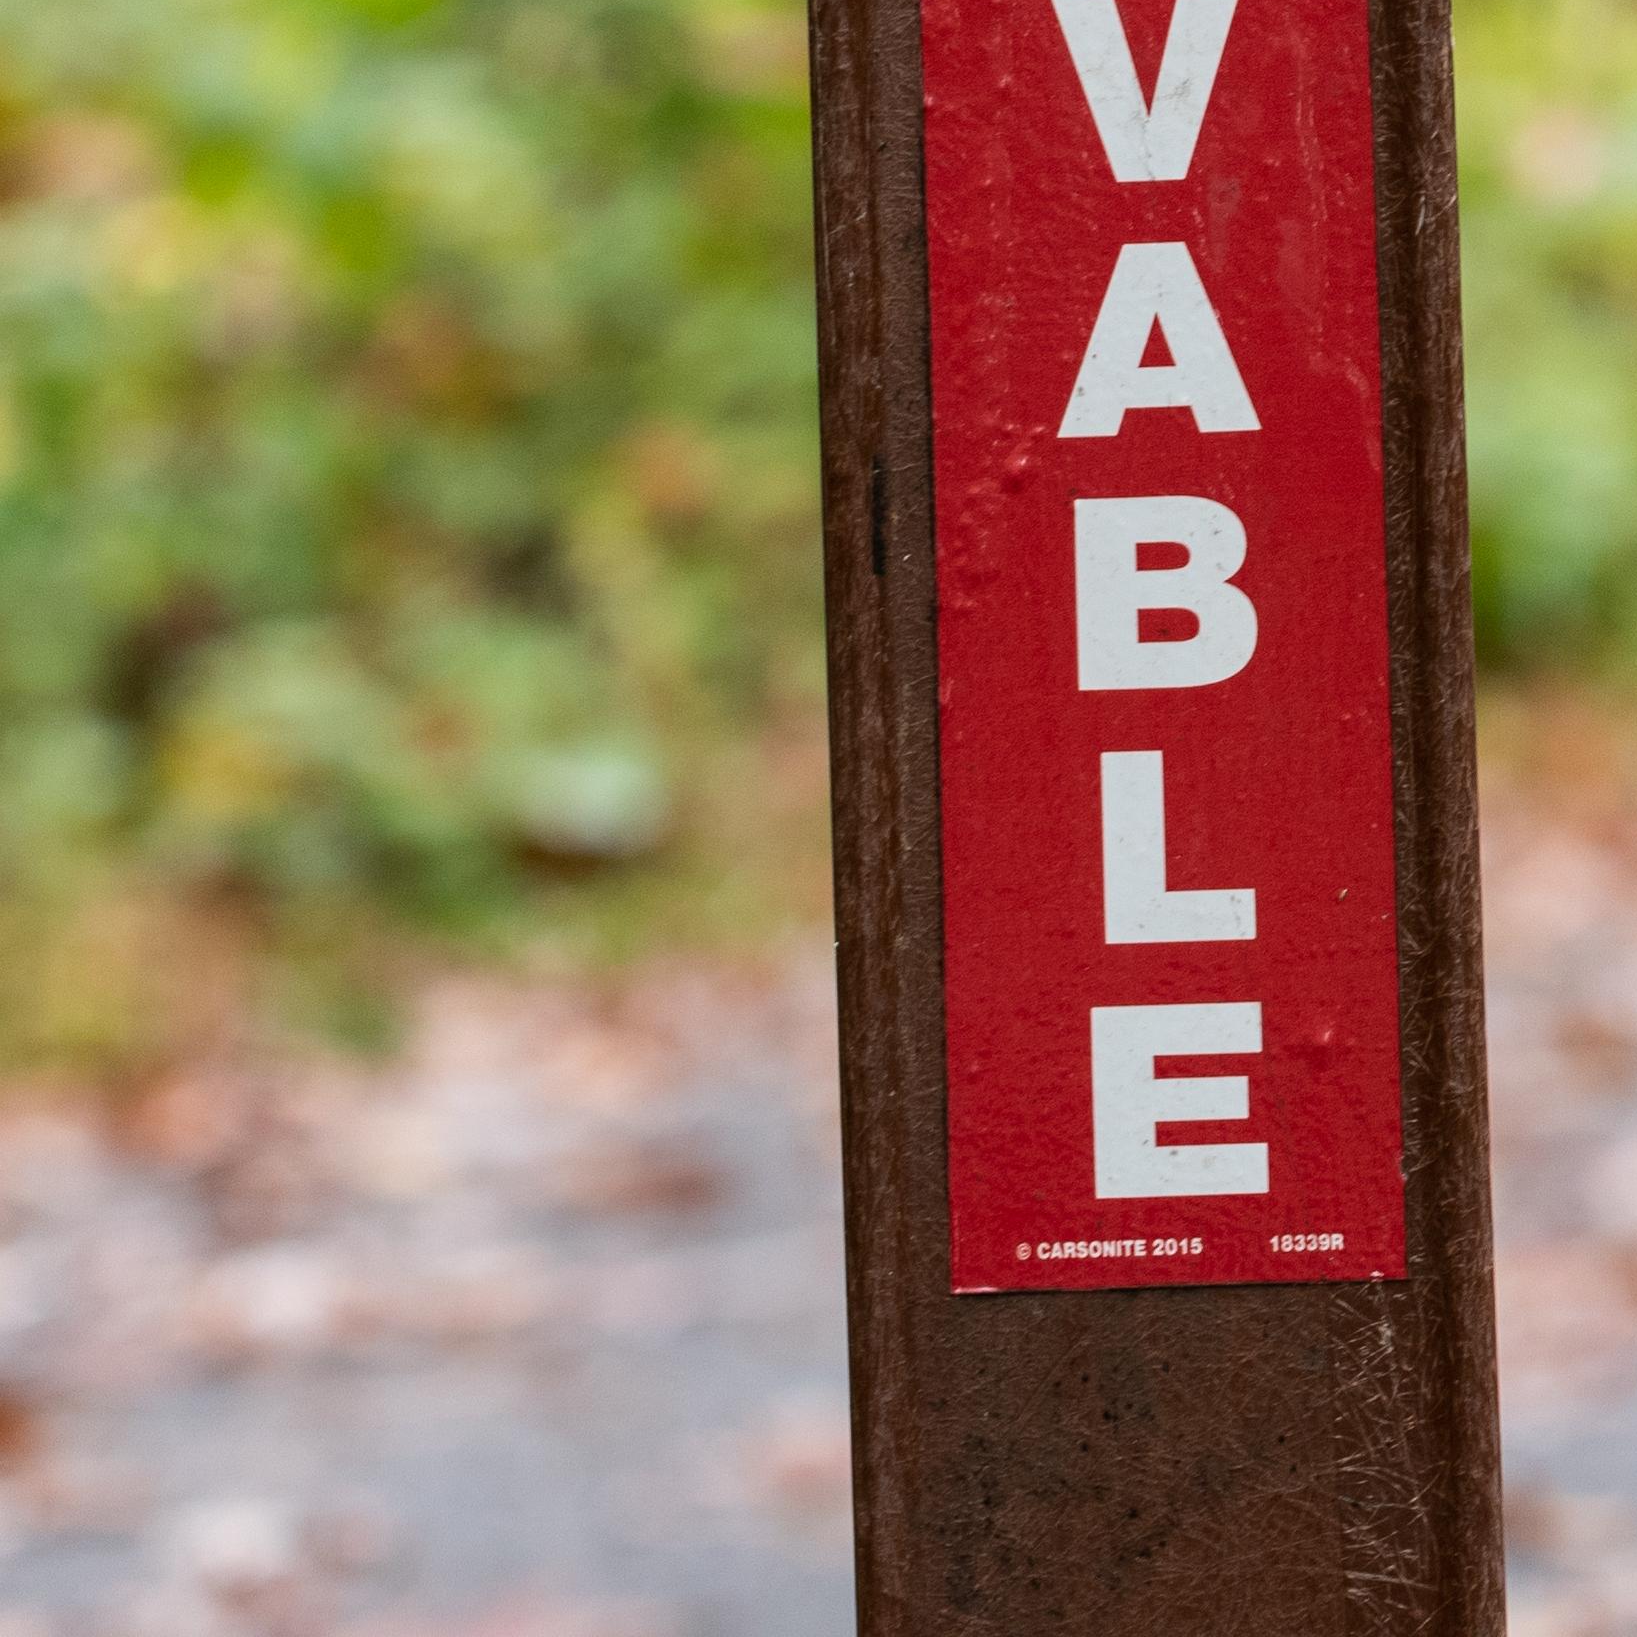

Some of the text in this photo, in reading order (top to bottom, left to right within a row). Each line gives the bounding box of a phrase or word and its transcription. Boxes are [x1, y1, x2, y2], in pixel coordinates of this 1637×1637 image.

[1036, 1239, 1147, 1260] CARSONITE
[1151, 1237, 1204, 1257] 2015
[1269, 1233, 1345, 1253] 18339R
